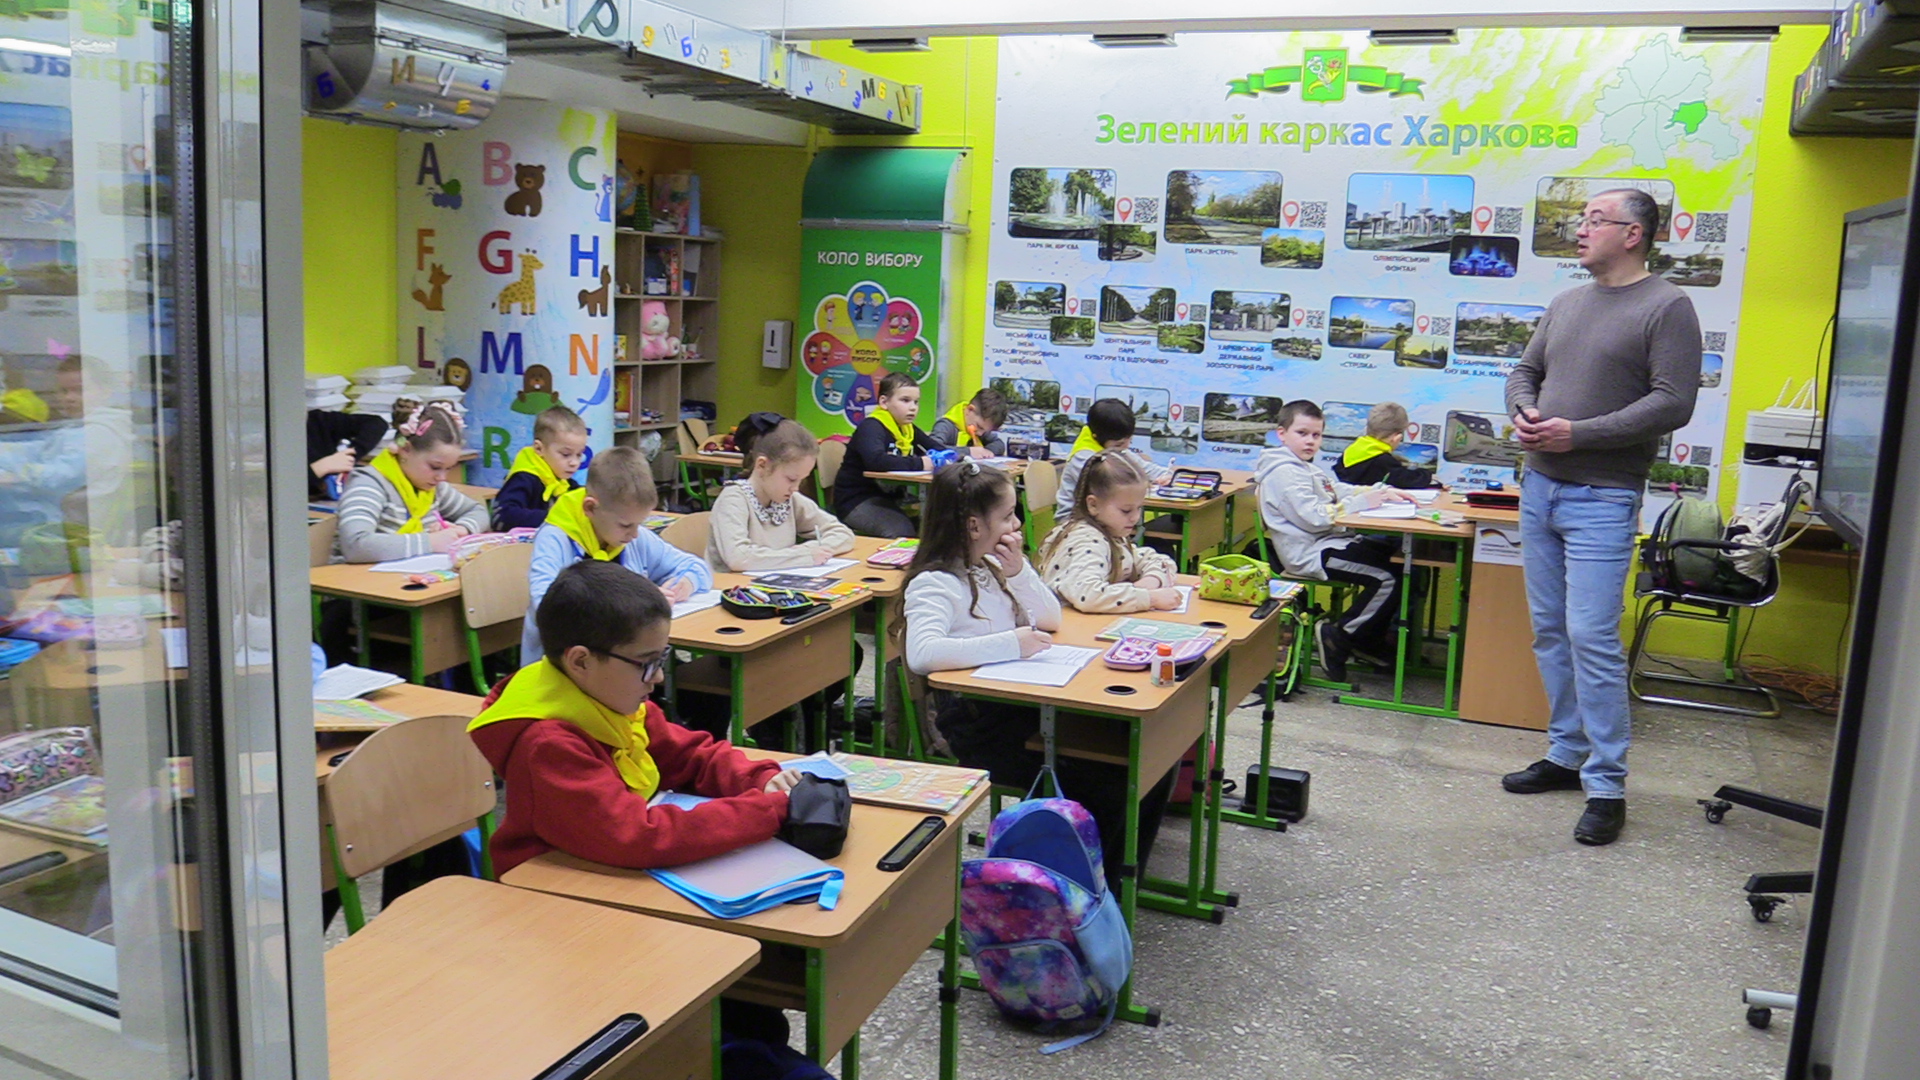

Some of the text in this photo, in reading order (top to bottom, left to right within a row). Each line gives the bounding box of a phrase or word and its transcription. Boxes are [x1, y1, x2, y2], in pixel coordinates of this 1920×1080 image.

[1095, 114, 1578, 156] Зелений каркас Харкова
[482, 141, 514, 186] B
[568, 146, 598, 191] C
[417, 228, 600, 278] F G H
[817, 251, 923, 268] КОЛО ВИБОРУ
[417, 326, 599, 376] L M N
[483, 426, 511, 470] R
